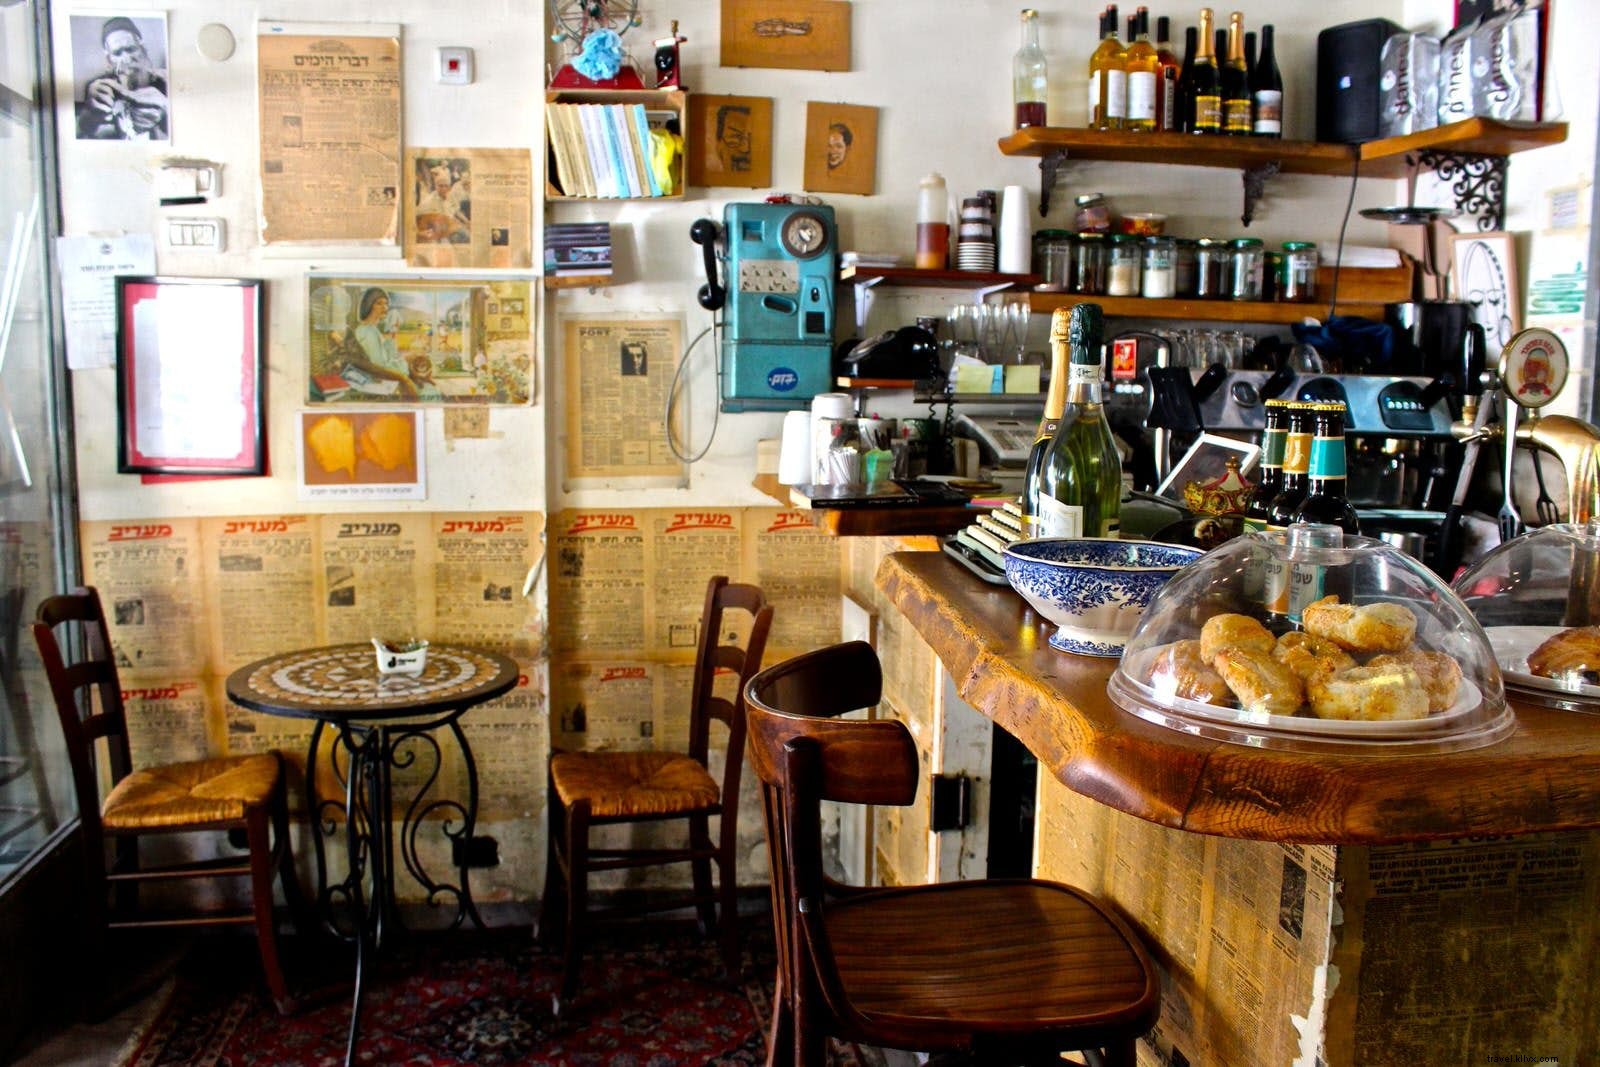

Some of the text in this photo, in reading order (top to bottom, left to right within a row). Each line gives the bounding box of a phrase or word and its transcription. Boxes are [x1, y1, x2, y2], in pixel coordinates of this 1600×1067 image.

[293, 55, 369, 67] דברי הימים
[571, 513, 636, 529] מעריב
[671, 511, 733, 527] מעריב
[108, 524, 173, 540] מעריב
[224, 520, 288, 534] מעריב
[338, 522, 402, 537] מעריב
[442, 520, 505, 533] מעריב
[603, 666, 647, 679] מעריב
